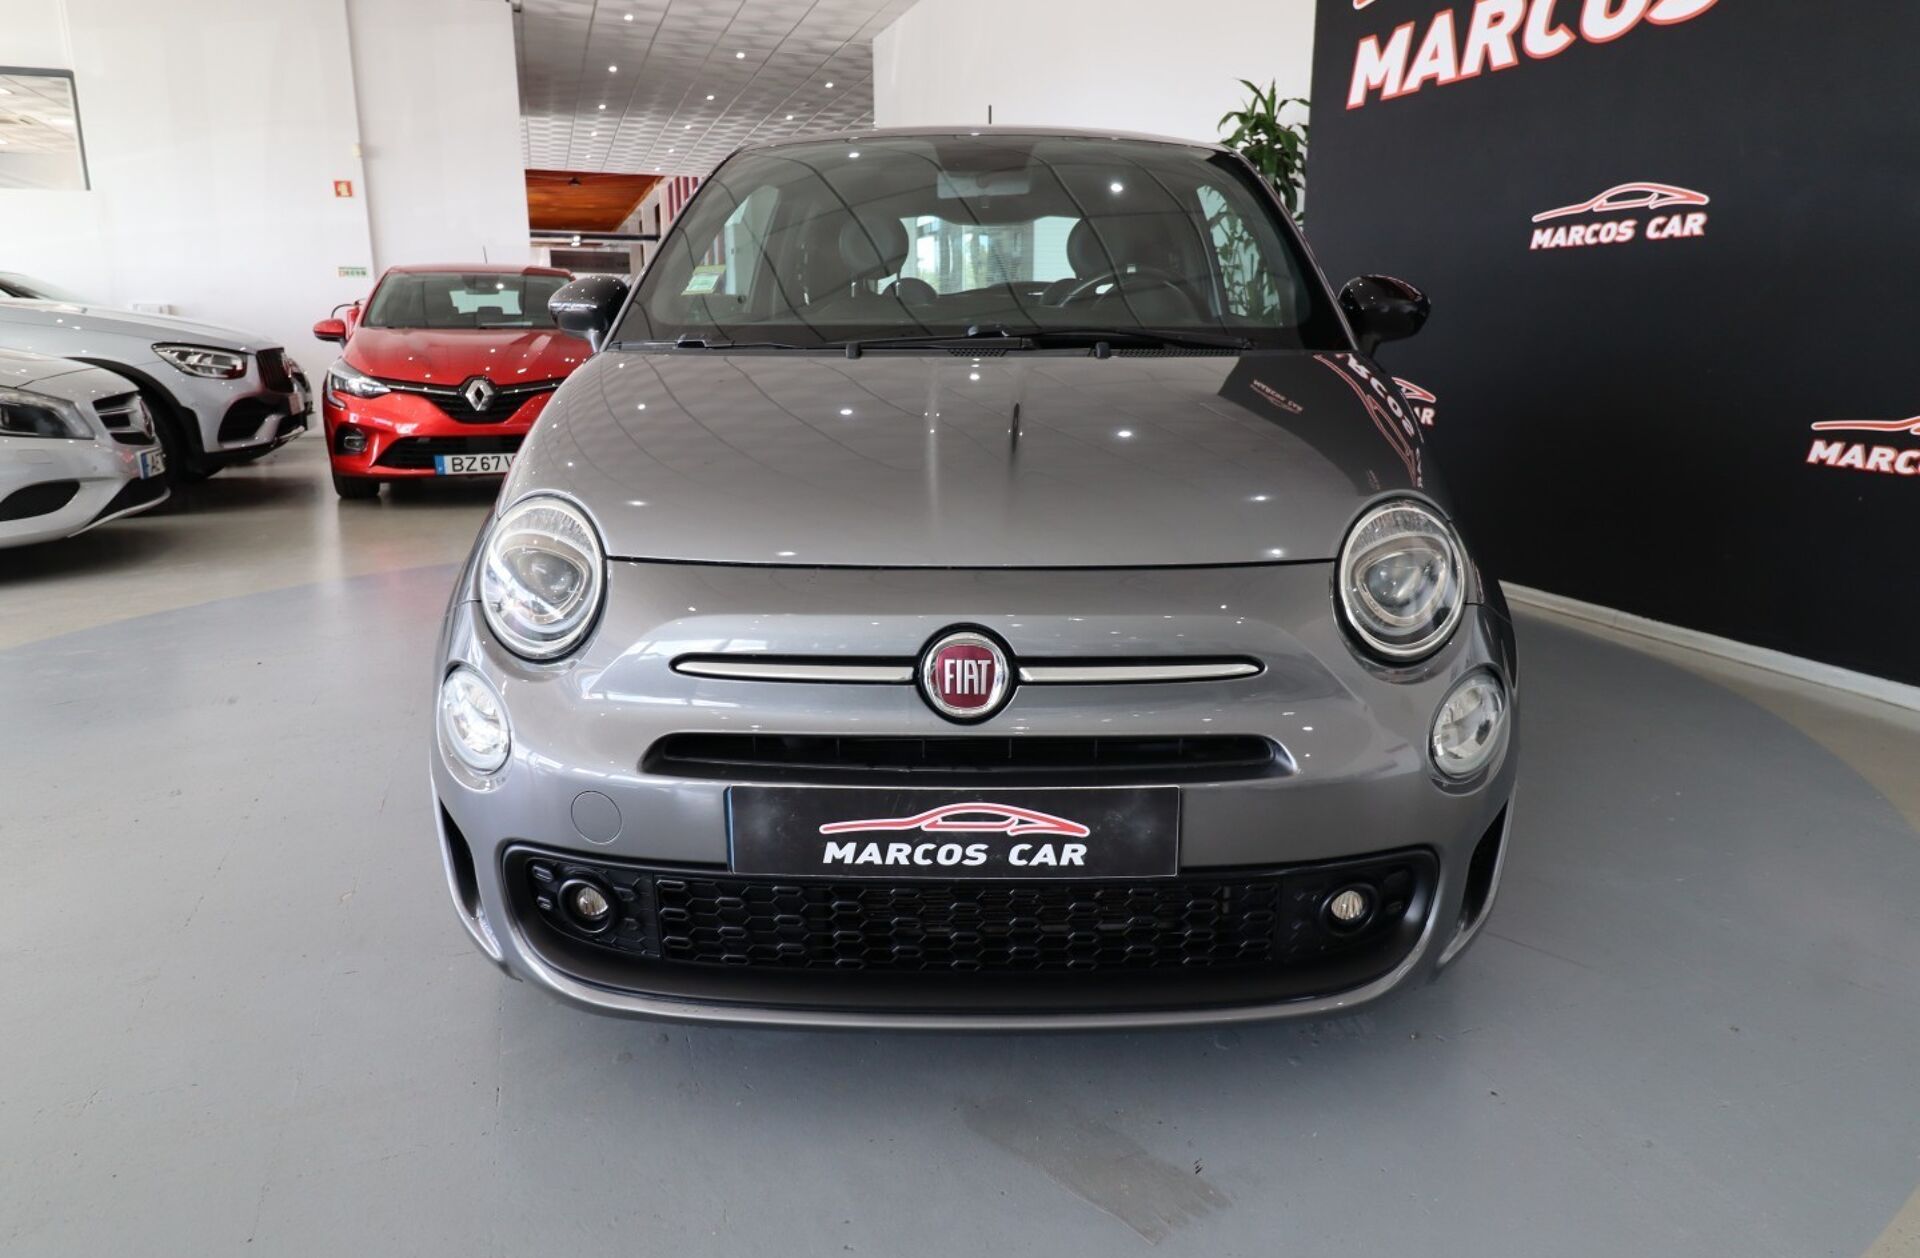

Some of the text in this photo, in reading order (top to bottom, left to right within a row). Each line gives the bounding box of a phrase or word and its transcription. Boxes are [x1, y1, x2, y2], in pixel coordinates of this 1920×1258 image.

[1346, 0, 1719, 110] MARC
[1530, 212, 1707, 250] MARCOS CAR
[1806, 439, 1920, 475] MARC
[944, 659, 992, 695] FIAT
[822, 841, 1087, 867] MARCOS CAR
